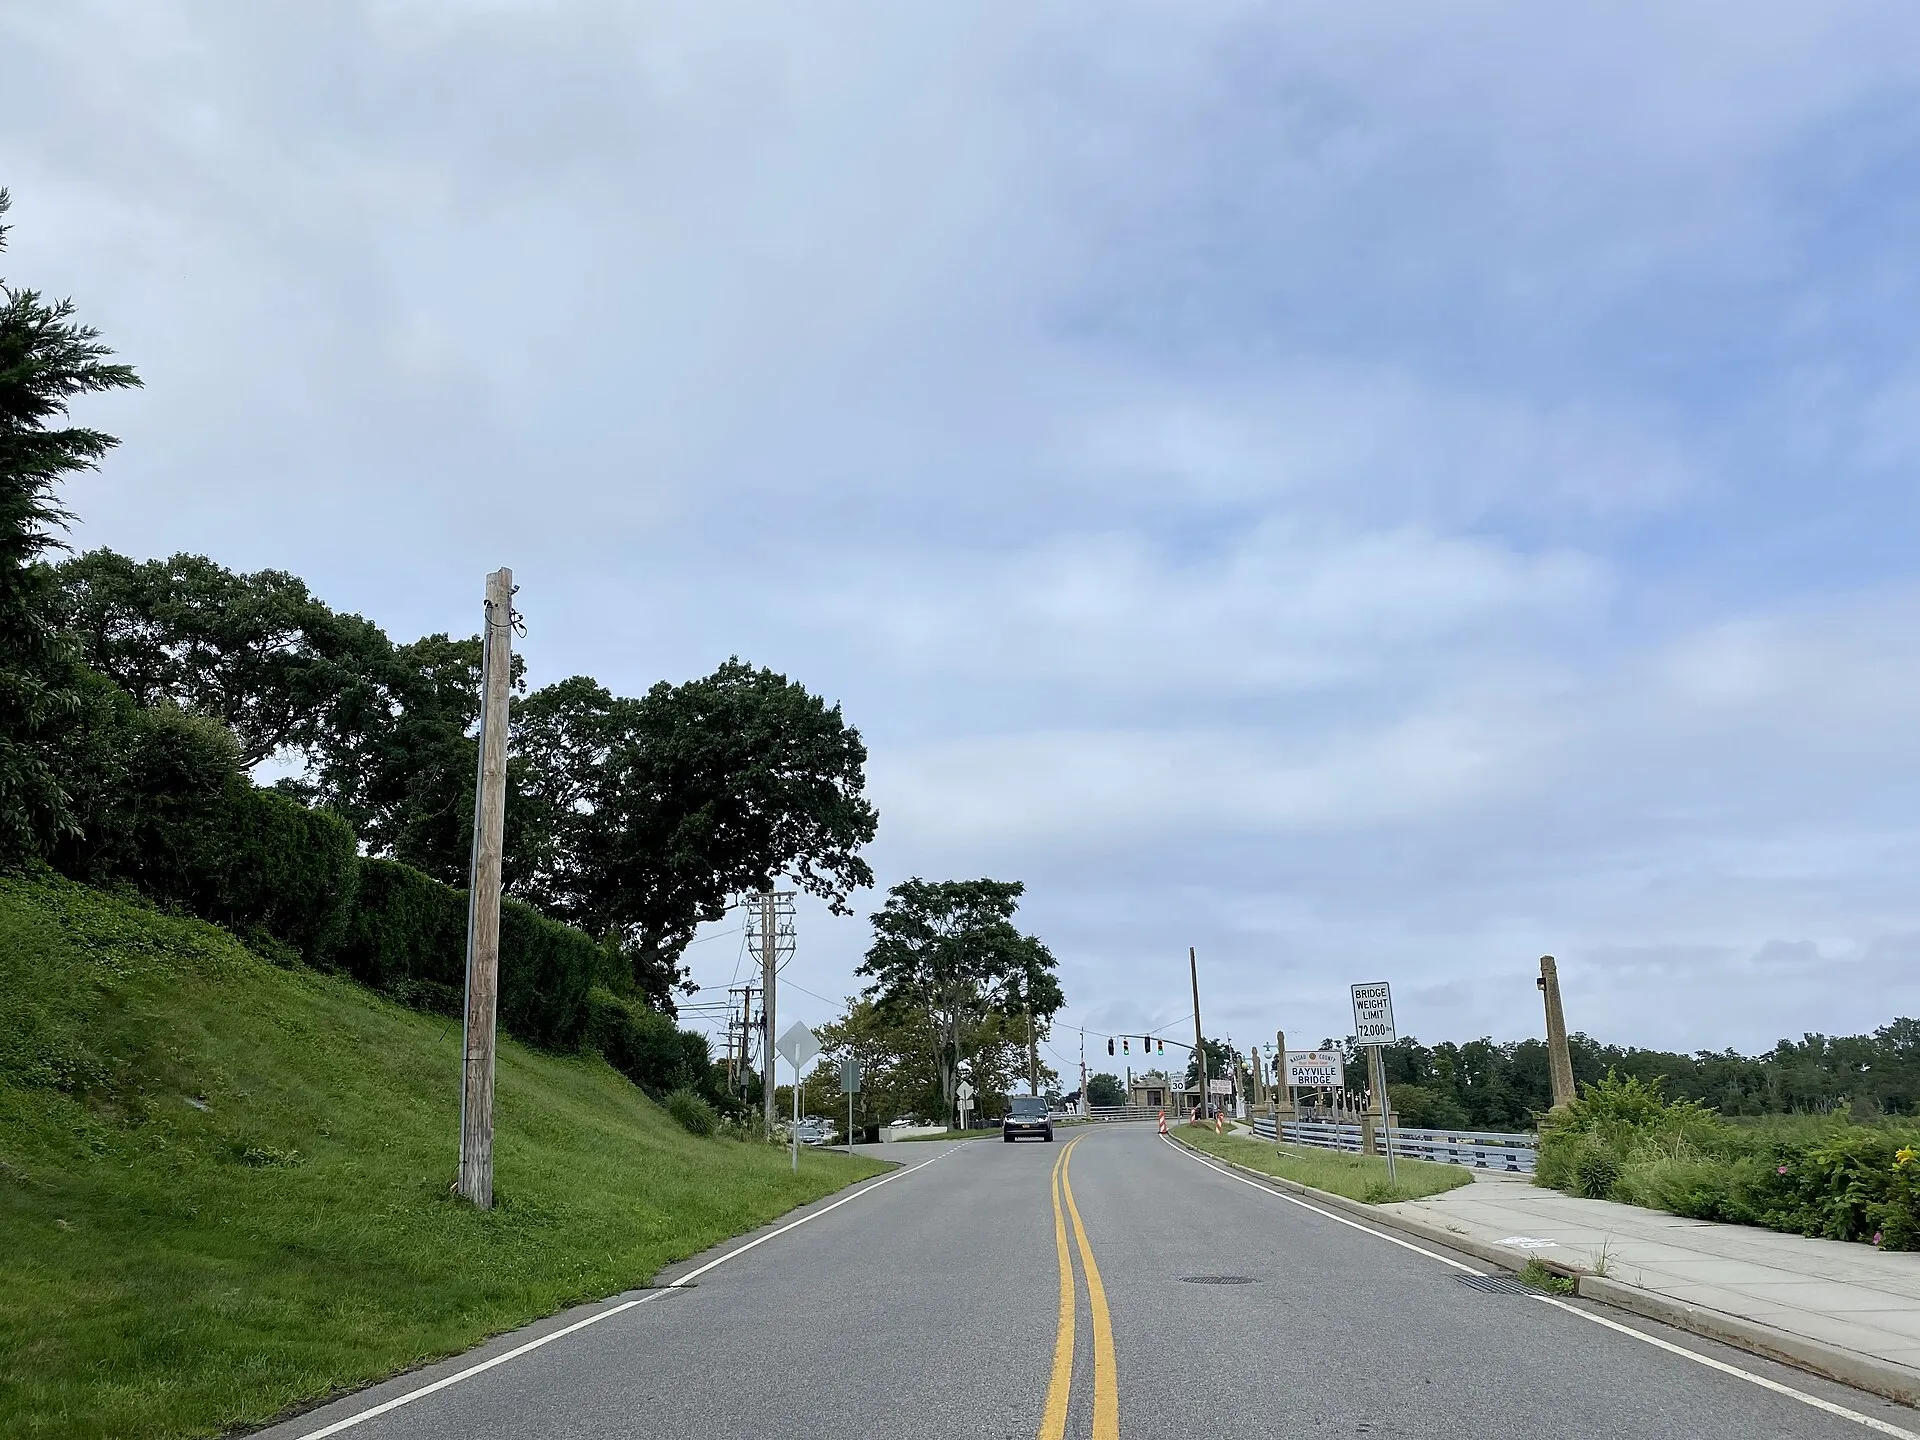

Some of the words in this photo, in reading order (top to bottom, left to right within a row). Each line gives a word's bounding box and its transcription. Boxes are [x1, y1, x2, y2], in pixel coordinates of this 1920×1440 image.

[1355, 988, 1387, 998] BRIDGE
[1356, 999, 1387, 1009] WEIGHT
[1362, 1010, 1383, 1019] LIMIT
[1292, 1067, 1336, 1076] BAYVILLE
[1298, 1076, 1331, 1084] BRIDGE
